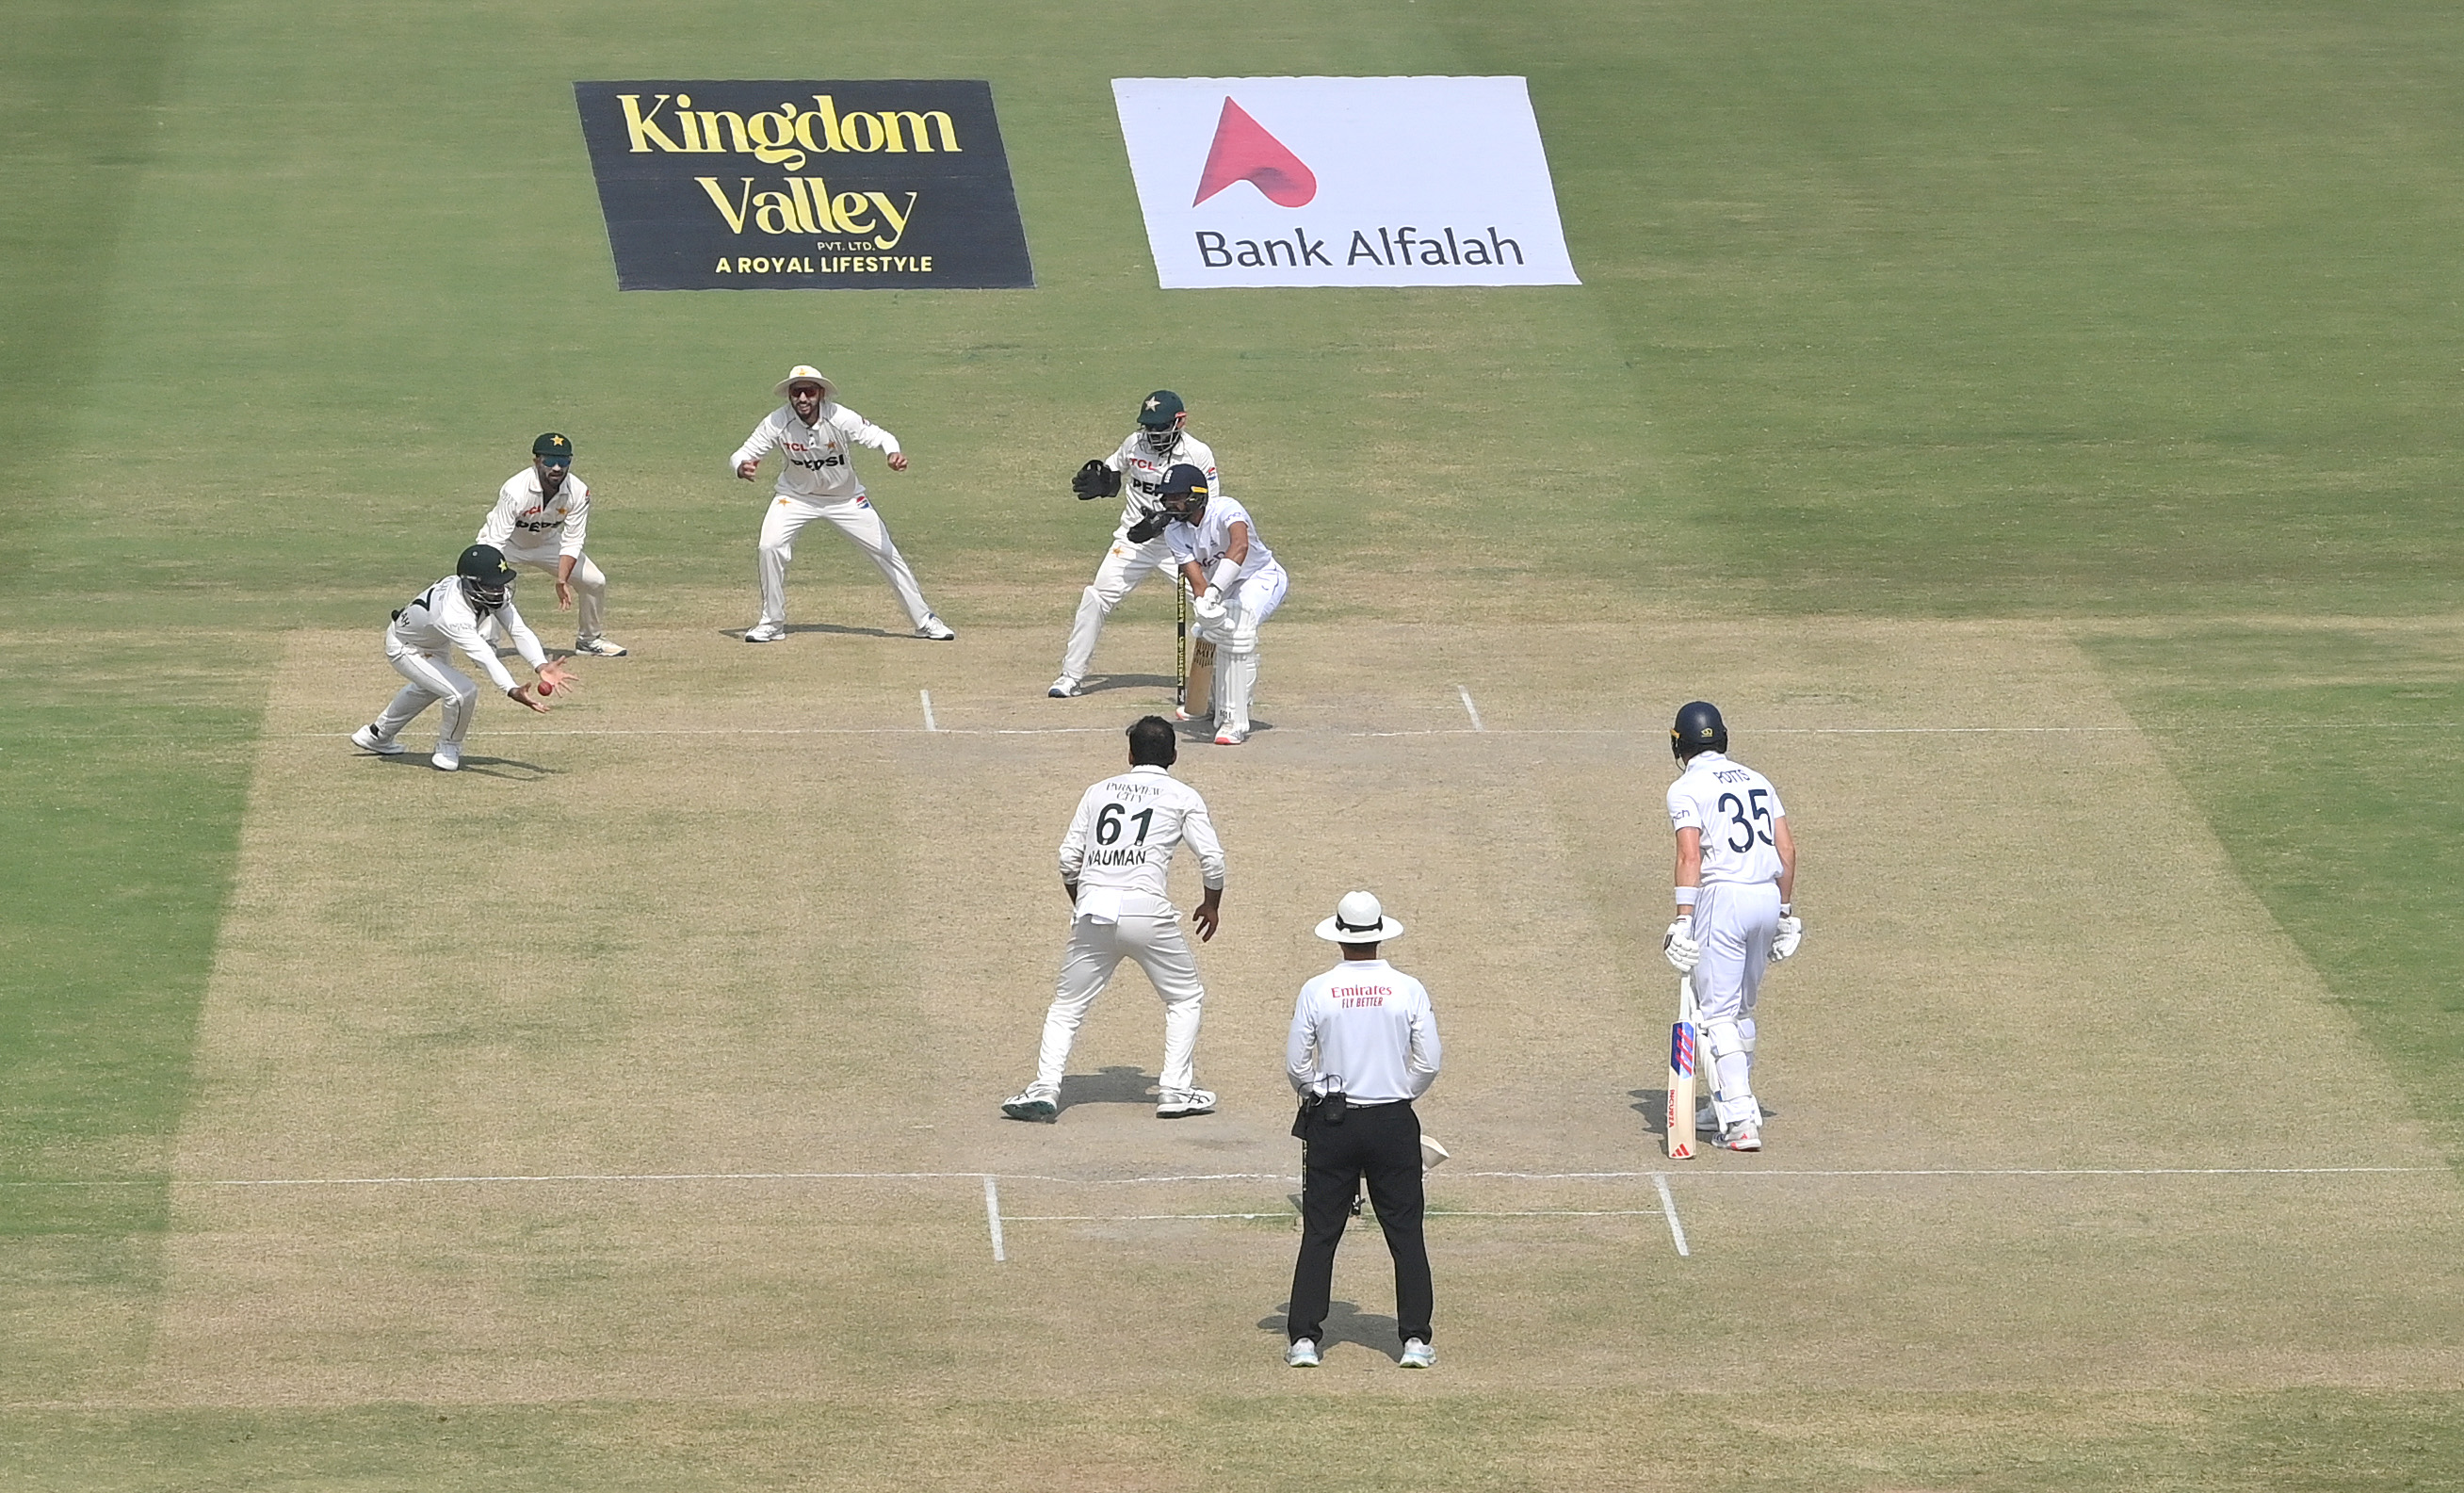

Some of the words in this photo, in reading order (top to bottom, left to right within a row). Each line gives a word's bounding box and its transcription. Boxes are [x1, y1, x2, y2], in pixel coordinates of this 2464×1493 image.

[616, 93, 963, 171] Kingdom
[694, 176, 917, 251] Valley
[817, 241, 846, 252] PVT.
[848, 241, 876, 252] LTD.
[1195, 227, 1333, 268] Bank
[1347, 226, 1524, 267] Alfalah
[715, 257, 732, 273] A
[738, 256, 815, 273] ROYAL
[820, 255, 932, 272] LIFESTYLE
[783, 442, 808, 452] TCL
[1129, 458, 1158, 471] TCL
[1712, 769, 1750, 785] POTTS
[1095, 803, 1154, 847] 61
[1717, 788, 1775, 853] 35
[1086, 849, 1146, 868] NAUMAN
[1331, 983, 1393, 998] Emirates
[1341, 998, 1354, 1010] FLY
[1355, 997, 1384, 1008] BETTER
